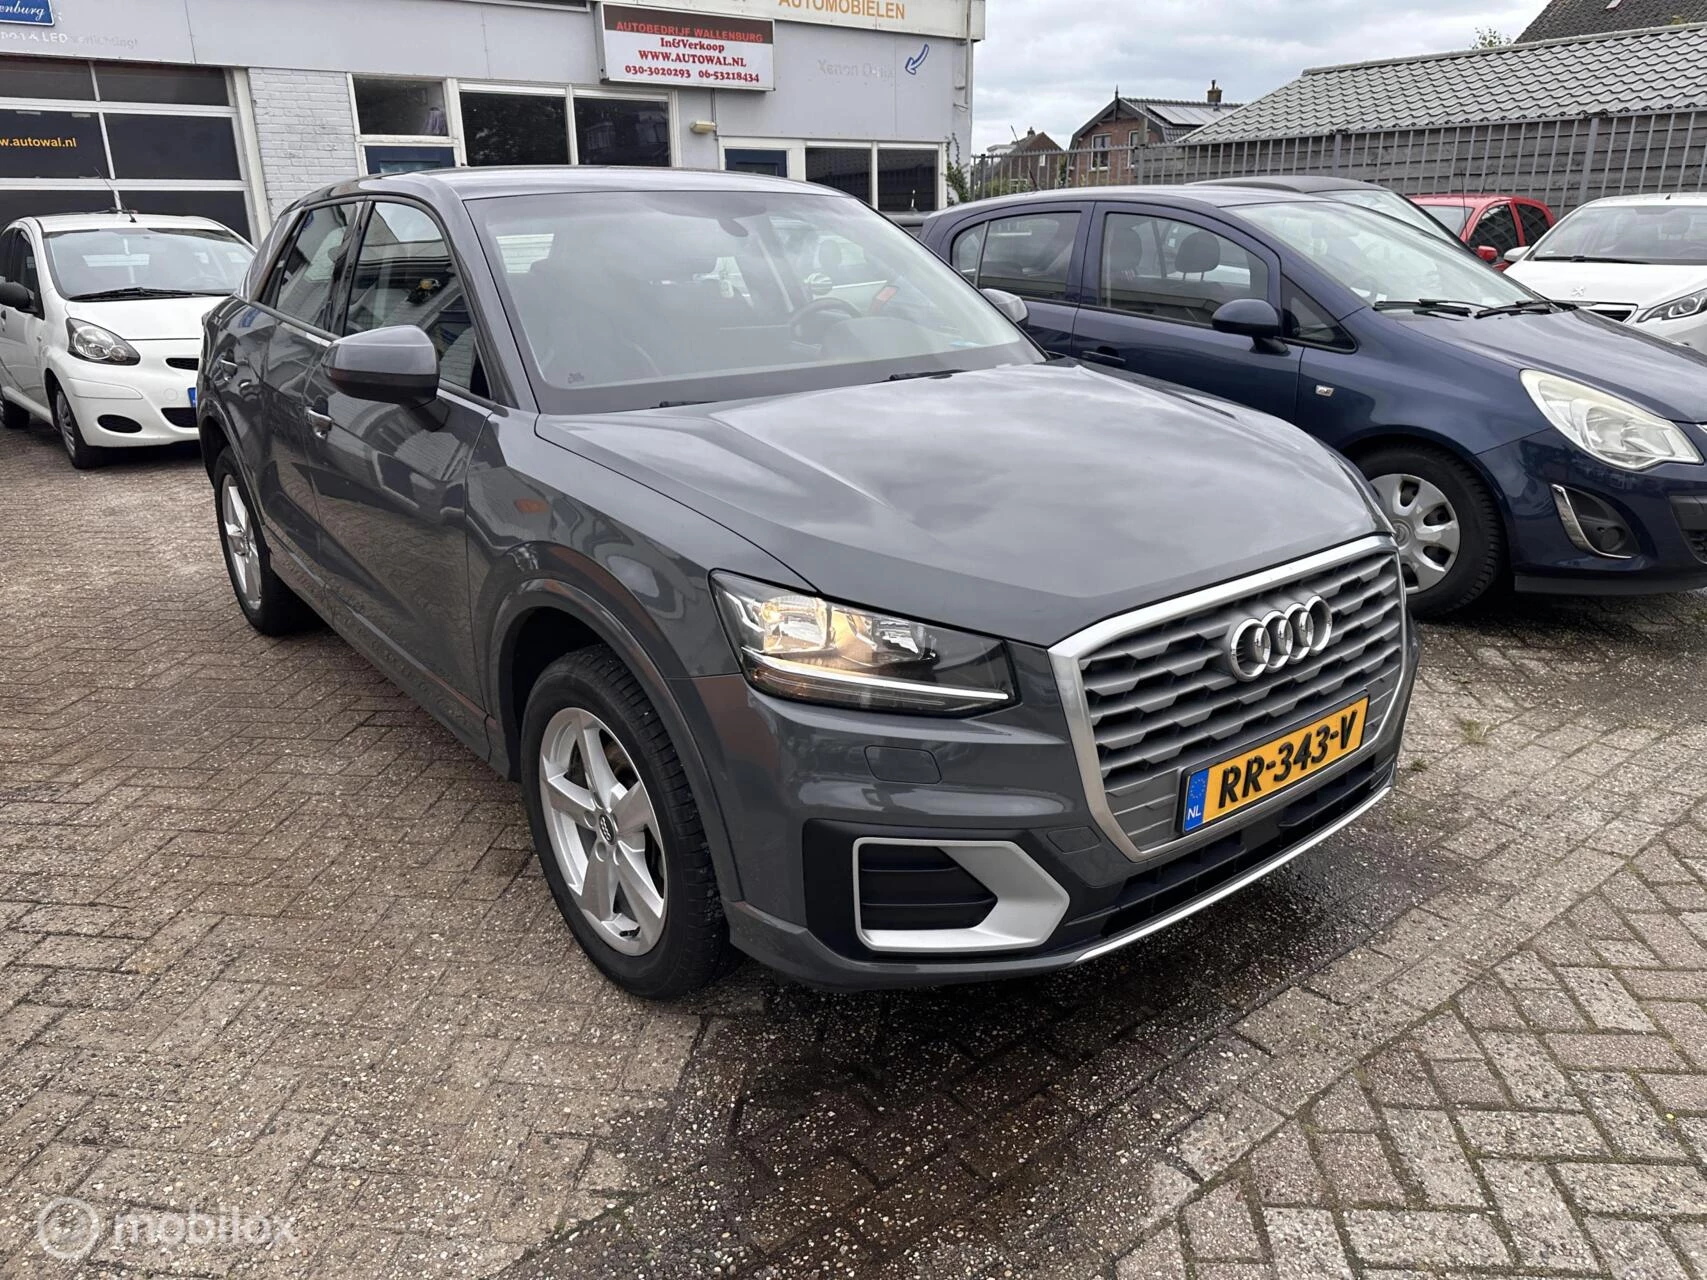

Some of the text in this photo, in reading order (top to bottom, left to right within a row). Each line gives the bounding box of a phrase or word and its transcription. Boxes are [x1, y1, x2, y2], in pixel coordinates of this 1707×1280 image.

[616, 21, 764, 42] AUTOBEDRIJF WALLENBURG
[660, 37, 725, 53] In&Verkoop
[638, 50, 747, 67] WWW.AUTOWAL.NL
[625, 65, 760, 83] 030-3020293 06-53218434
[0, 137, 77, 148] w.autowal.nl
[1218, 709, 1358, 809] RR-343-V
[1187, 805, 1201, 820] NL
